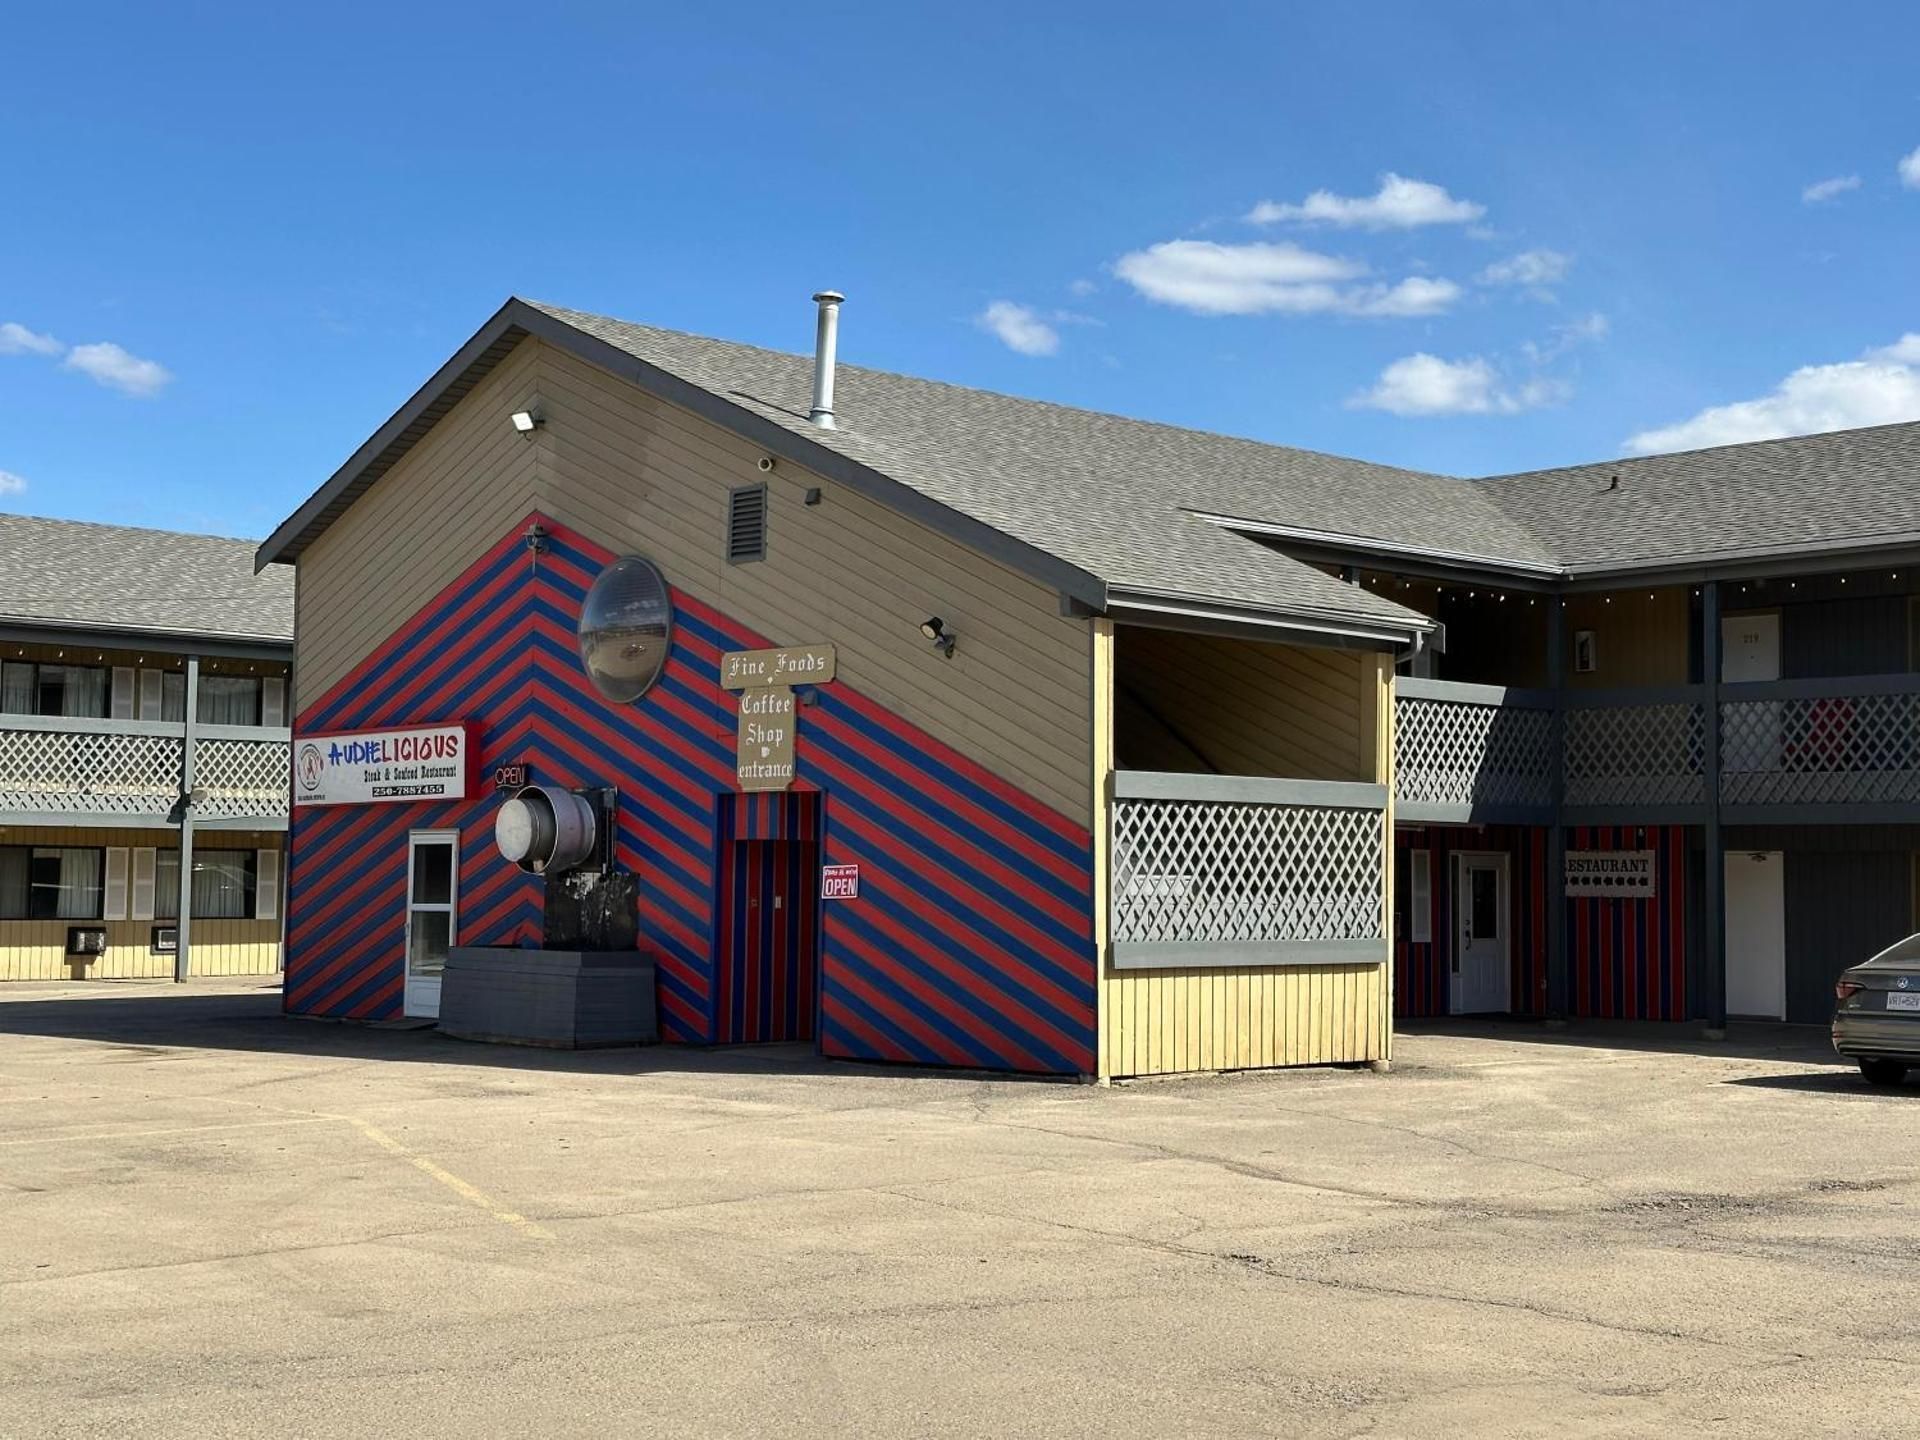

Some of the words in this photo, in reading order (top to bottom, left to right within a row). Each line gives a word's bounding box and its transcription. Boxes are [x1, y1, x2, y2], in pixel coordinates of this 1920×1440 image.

[729, 657, 764, 677] Fine
[774, 653, 825, 676] Foods
[741, 694, 790, 714] Coffee
[745, 722, 783, 747] Shop
[328, 735, 458, 766] AUDIELICIOUS
[364, 770, 381, 783] Steak
[384, 767, 390, 781] &
[394, 766, 418, 780] Seafood
[421, 764, 456, 779] Restaurant
[495, 767, 524, 784] OPEN
[739, 761, 792, 777] entrance
[373, 786, 442, 796] 250-7887455
[1565, 859, 1648, 873] ESTAURANT
[825, 878, 856, 896] OPEN
